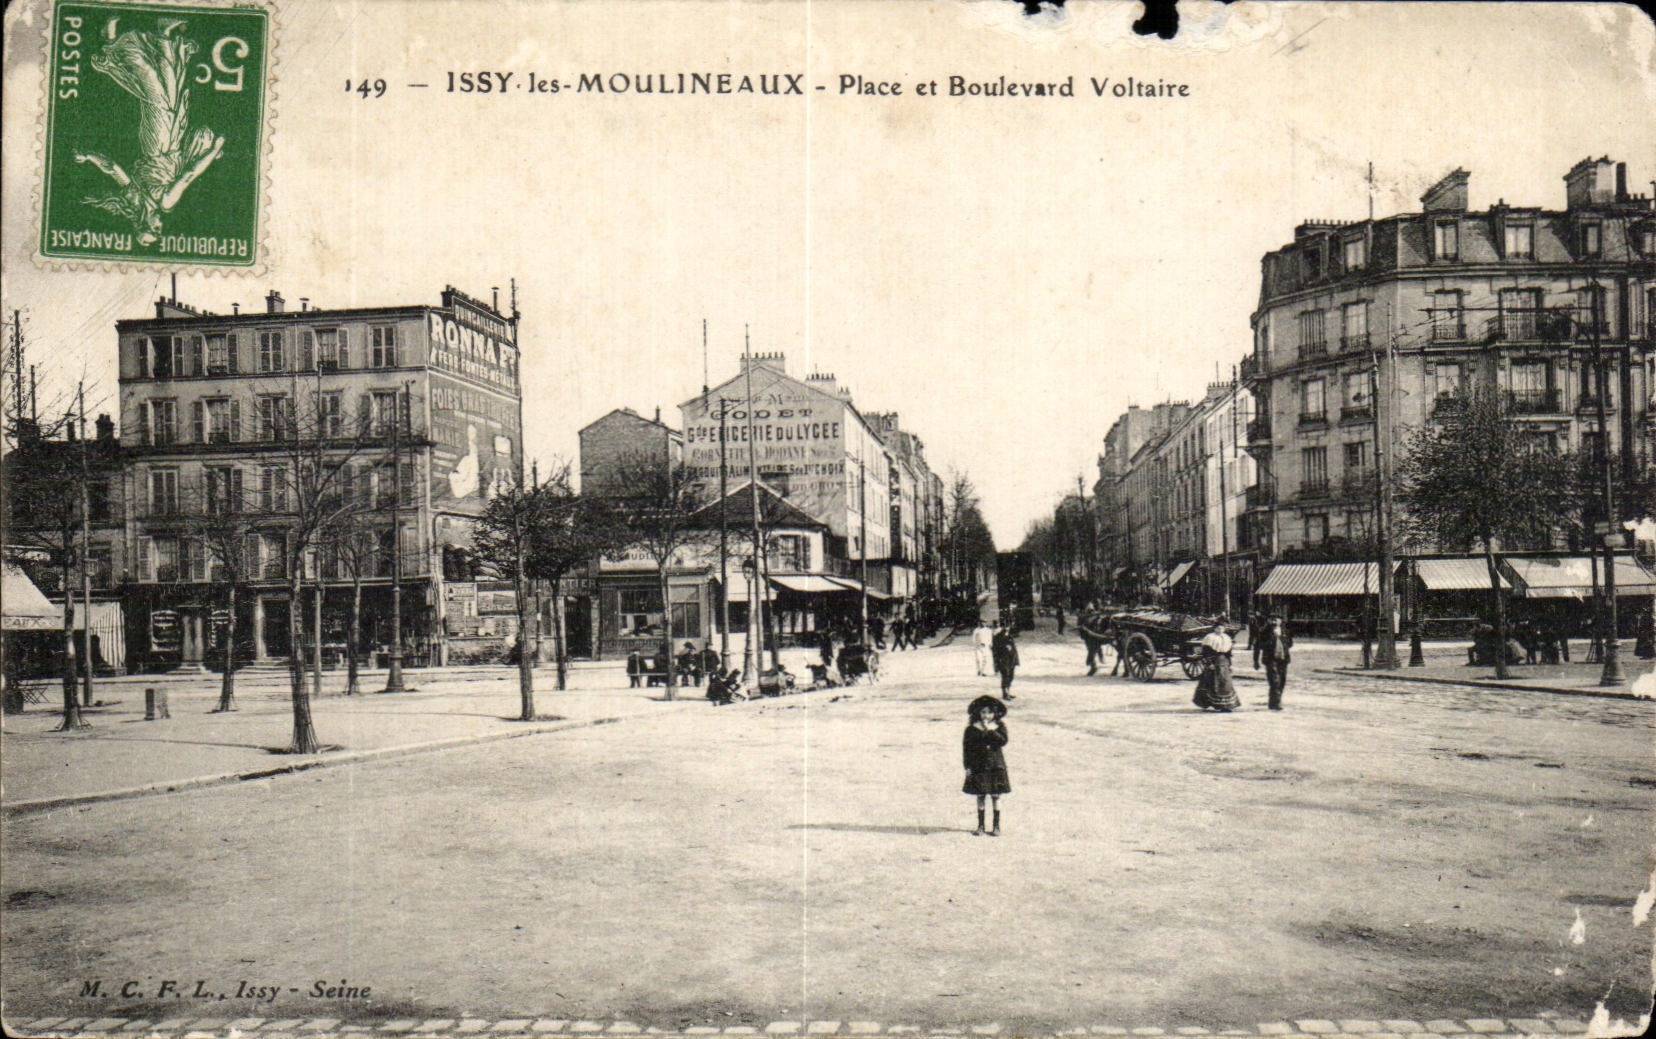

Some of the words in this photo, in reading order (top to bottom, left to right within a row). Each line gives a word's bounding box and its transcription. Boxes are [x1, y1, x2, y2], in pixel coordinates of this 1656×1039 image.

[59, 16, 83, 100] POSTES
[50, 229, 132, 250] FRANÇAISE
[432, 388, 460, 410] FOIES
[710, 409, 813, 421] GODET
